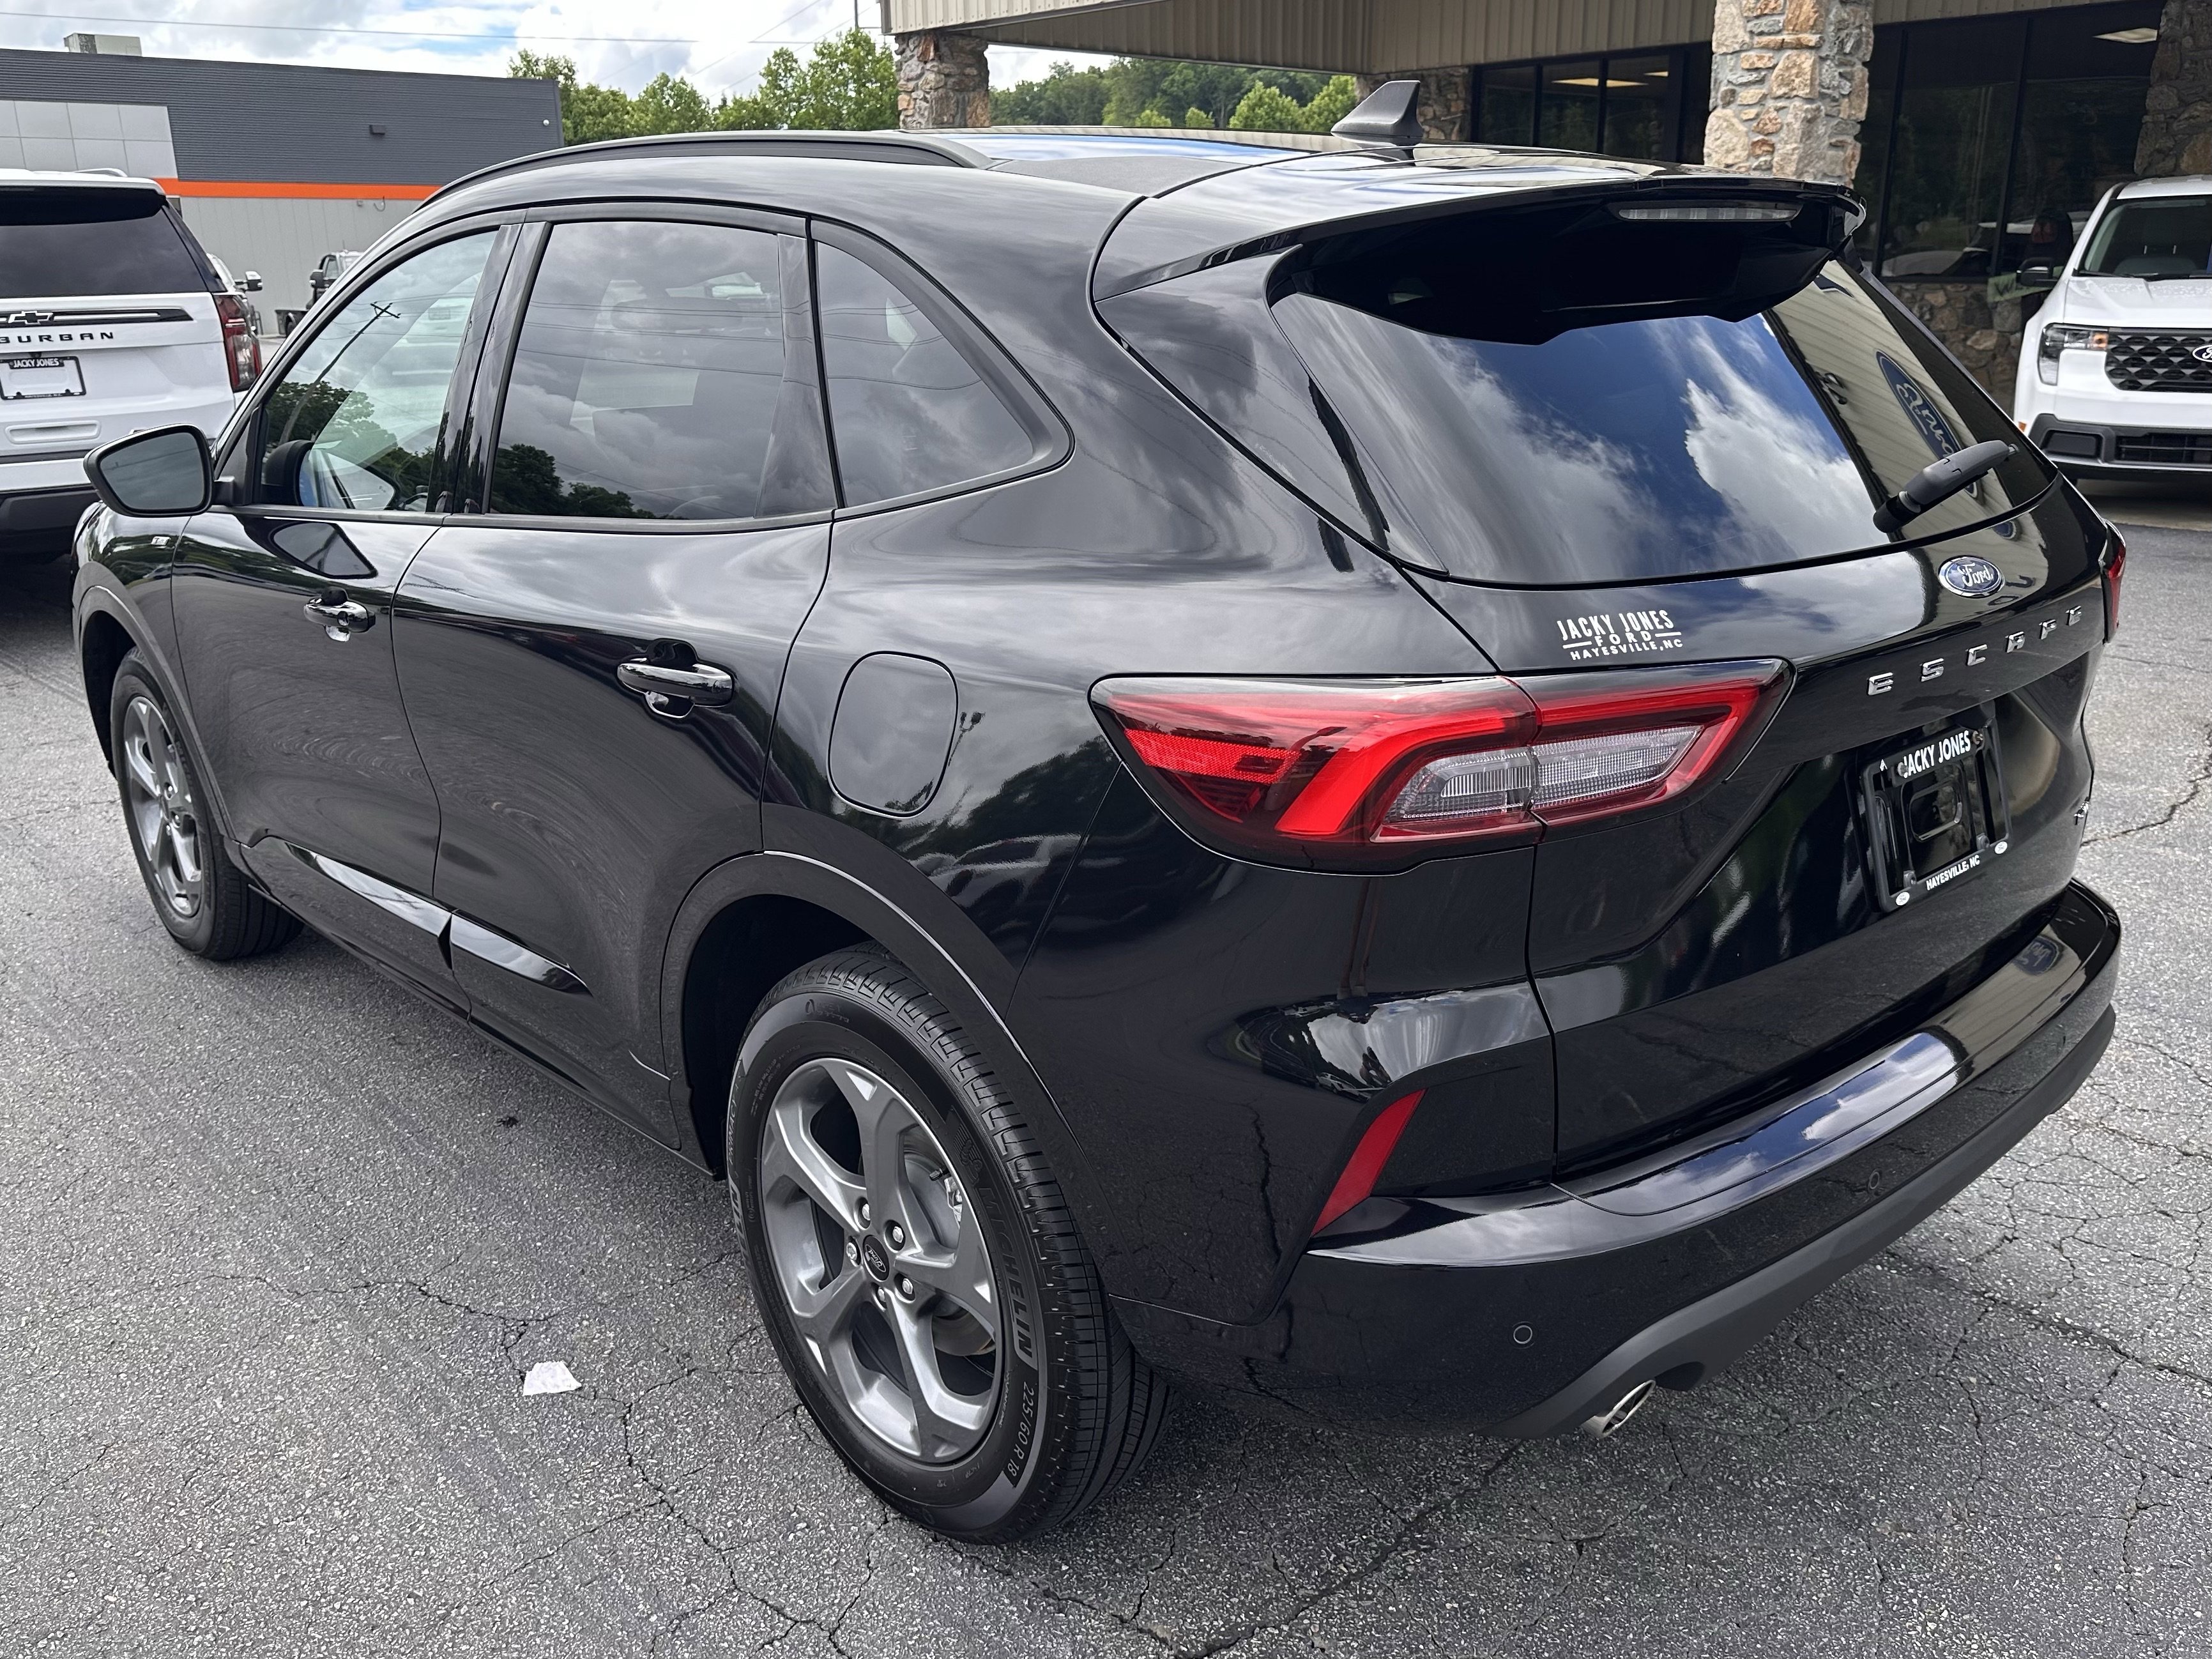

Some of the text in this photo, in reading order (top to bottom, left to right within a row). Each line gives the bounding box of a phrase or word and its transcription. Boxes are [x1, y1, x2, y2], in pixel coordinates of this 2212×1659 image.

[13, 358, 59, 368] JACKY JONES
[1956, 562, 1994, 586] Ford
[1557, 609, 1674, 641] JACKY JONES
[1594, 631, 1652, 647] FORD
[1866, 605, 2082, 696] ESCAPE
[1903, 730, 1971, 778] JACKY JONES
[1926, 854, 1980, 891] HAYESVILLE, NC
[1007, 1381, 1035, 1477] 225/60 R 18
